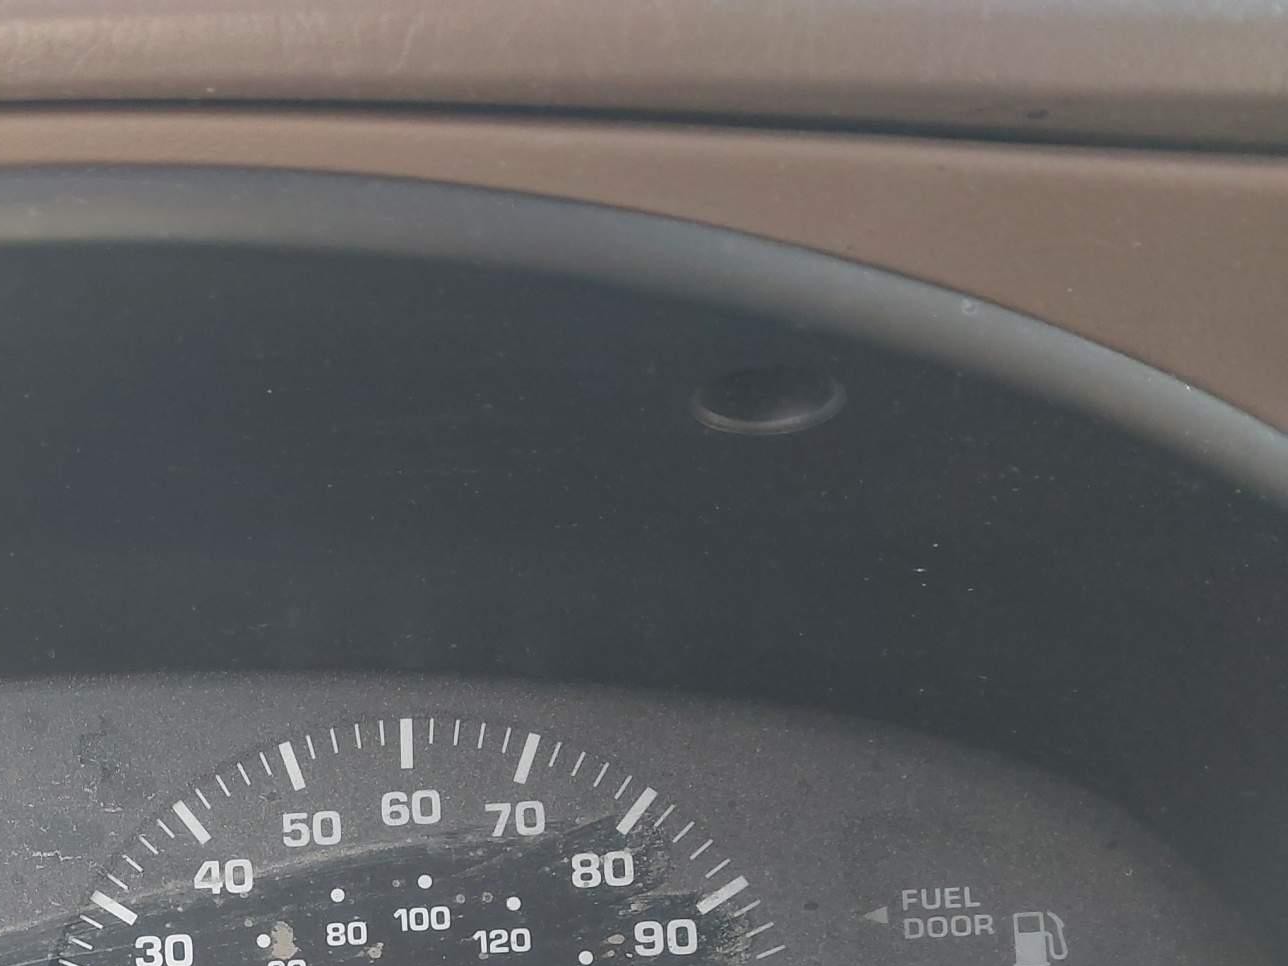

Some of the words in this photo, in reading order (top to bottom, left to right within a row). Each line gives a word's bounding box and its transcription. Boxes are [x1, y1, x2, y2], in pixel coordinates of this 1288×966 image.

[380, 789, 441, 826] 60
[485, 800, 545, 837] 70
[282, 810, 342, 847] 50
[194, 859, 254, 894] 40
[571, 851, 634, 888] 80
[902, 886, 981, 911] FUEL
[326, 921, 368, 946] 80
[393, 906, 451, 931] 100
[903, 914, 996, 939] DOOR
[472, 927, 531, 954] 120
[633, 918, 697, 956] 90
